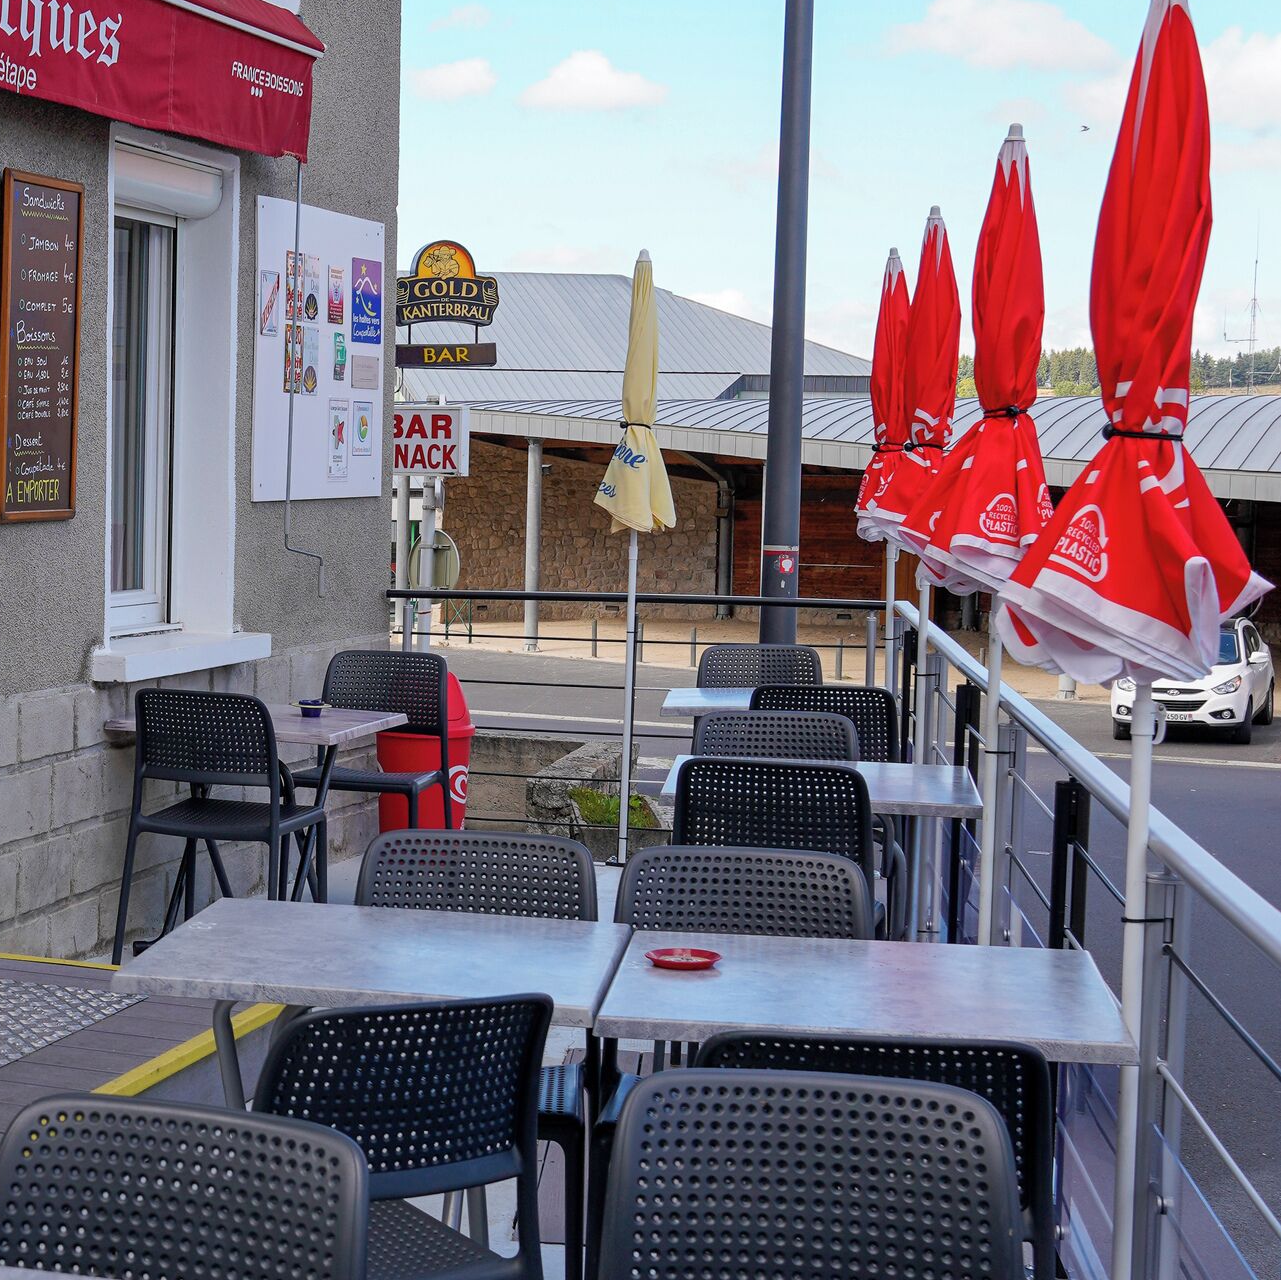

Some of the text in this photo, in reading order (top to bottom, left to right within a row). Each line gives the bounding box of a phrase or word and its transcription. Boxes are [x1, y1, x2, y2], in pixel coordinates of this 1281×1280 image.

[23, 187, 65, 211] Sandwichs
[28, 233, 75, 252] JAMBON 4€
[28, 262, 75, 284] FROMAGE 4€
[413, 280, 478, 298] GOLD
[25, 297, 73, 313] COMPLET 5€
[402, 303, 490, 322] KANTERBRÄU
[16, 319, 56, 344] Boissons
[422, 346, 471, 364] BAR
[15, 431, 44, 450] Dessert
[394, 443, 457, 470] NACK
[5, 478, 60, 504] A EMPORTER
[1079, 516, 1097, 537] 100%
[1065, 526, 1100, 554] RECYCLED
